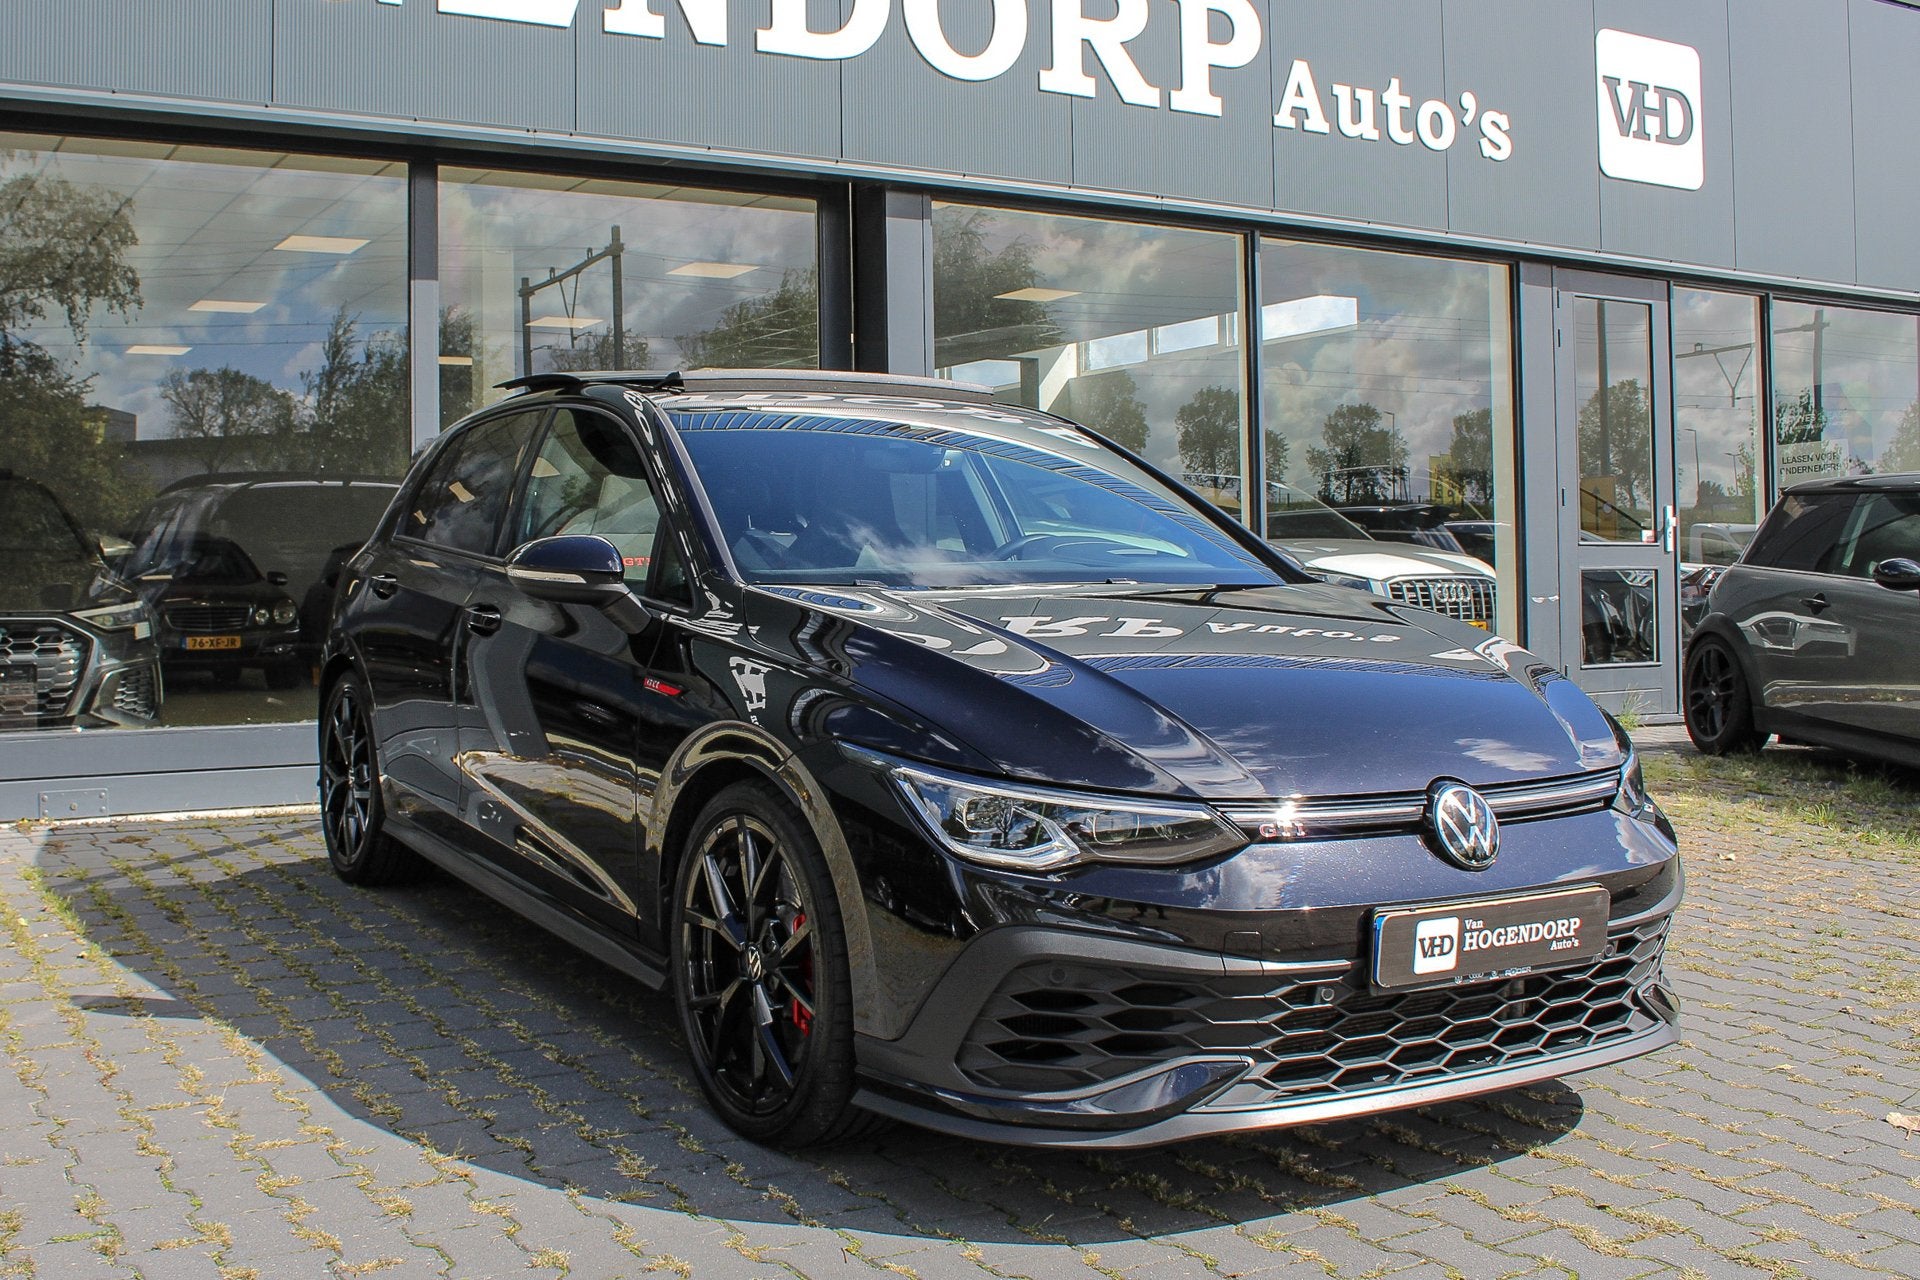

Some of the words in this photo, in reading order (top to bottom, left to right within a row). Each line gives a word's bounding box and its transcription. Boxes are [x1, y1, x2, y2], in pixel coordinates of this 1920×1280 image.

[1273, 59, 1513, 161] Auto's
[1602, 75, 1694, 146] VHD
[1782, 454, 1814, 464] LEASEN
[1463, 917, 1581, 951] HOGENDORP
[1464, 918, 1484, 930] Van
[1418, 934, 1455, 959] VHD
[1550, 937, 1579, 951] Auto's
